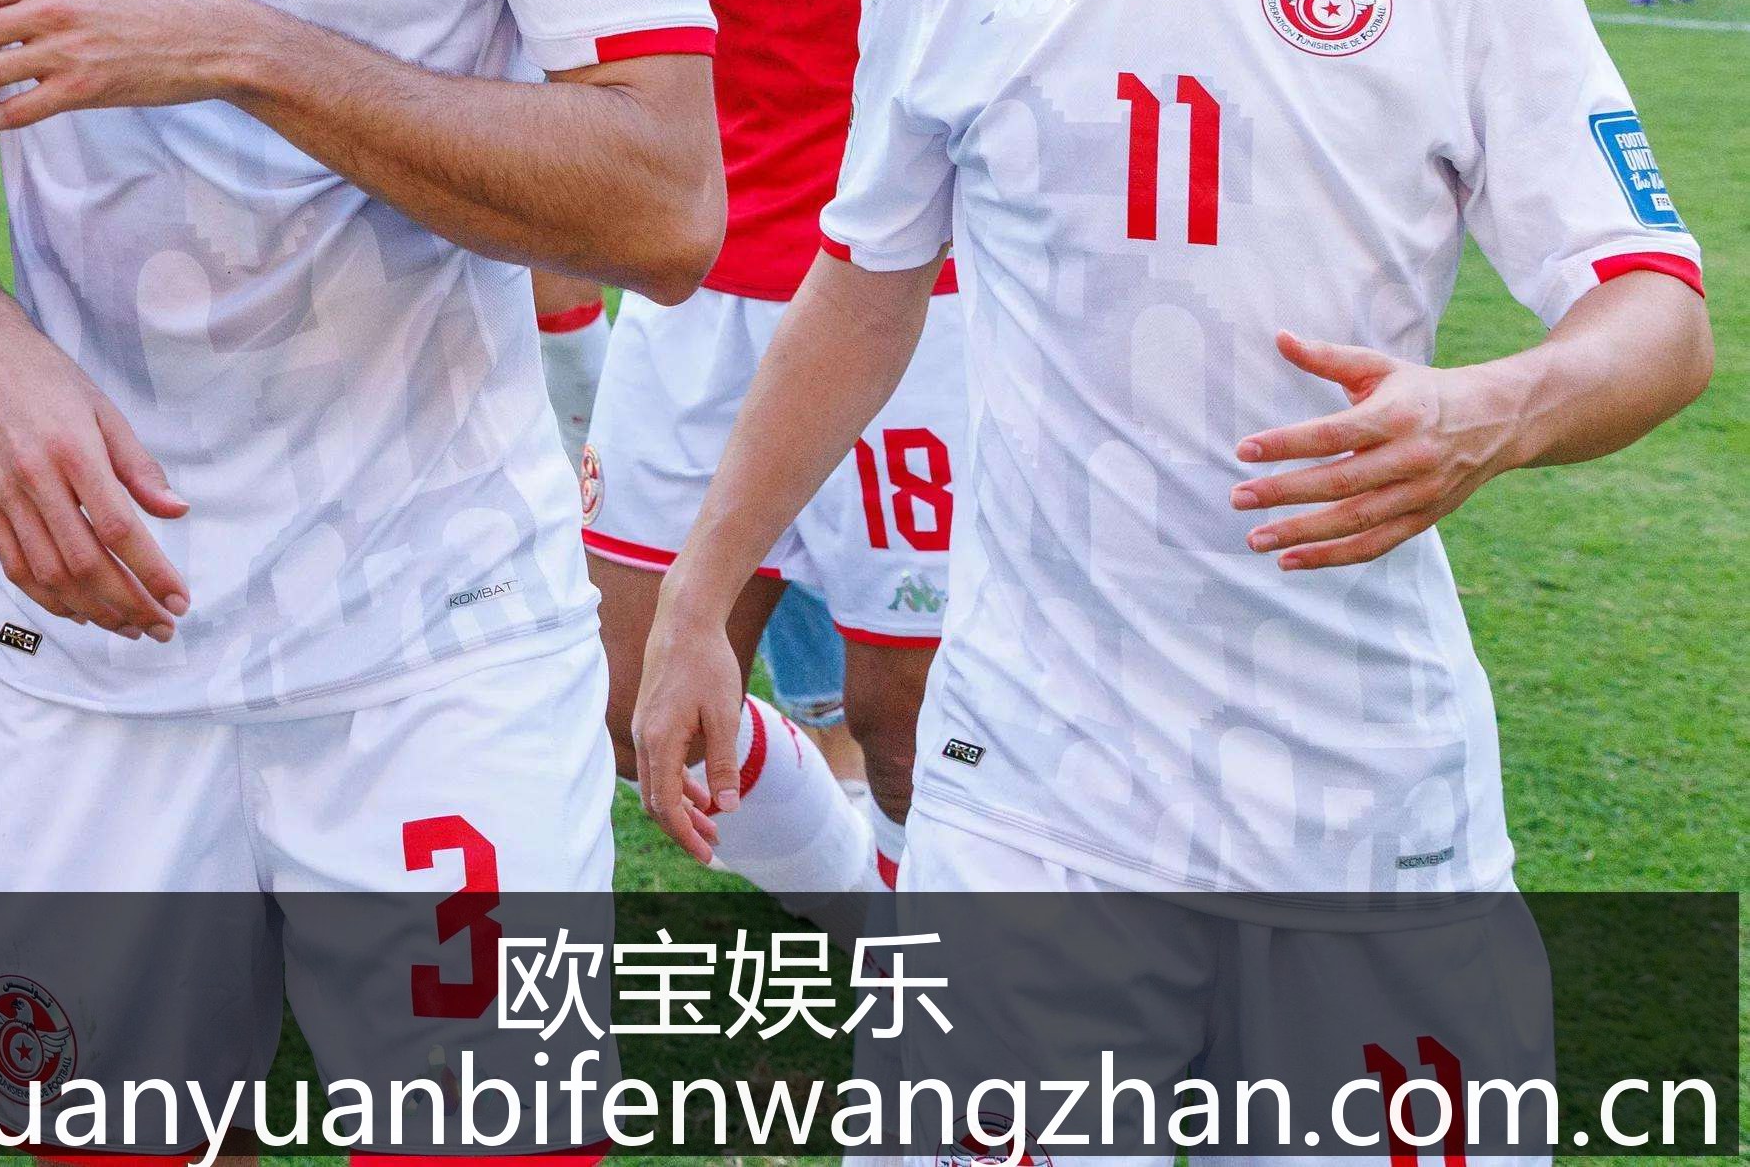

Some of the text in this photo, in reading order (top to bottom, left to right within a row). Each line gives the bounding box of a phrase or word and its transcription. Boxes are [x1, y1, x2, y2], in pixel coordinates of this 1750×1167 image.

[1296, 34, 1349, 50] TUNISIENNE
[1349, 38, 1362, 47] DE
[1116, 72, 1221, 246] 11
[853, 427, 954, 552] 18
[449, 580, 516, 607] KOMBAT
[402, 815, 502, 1019] 3
